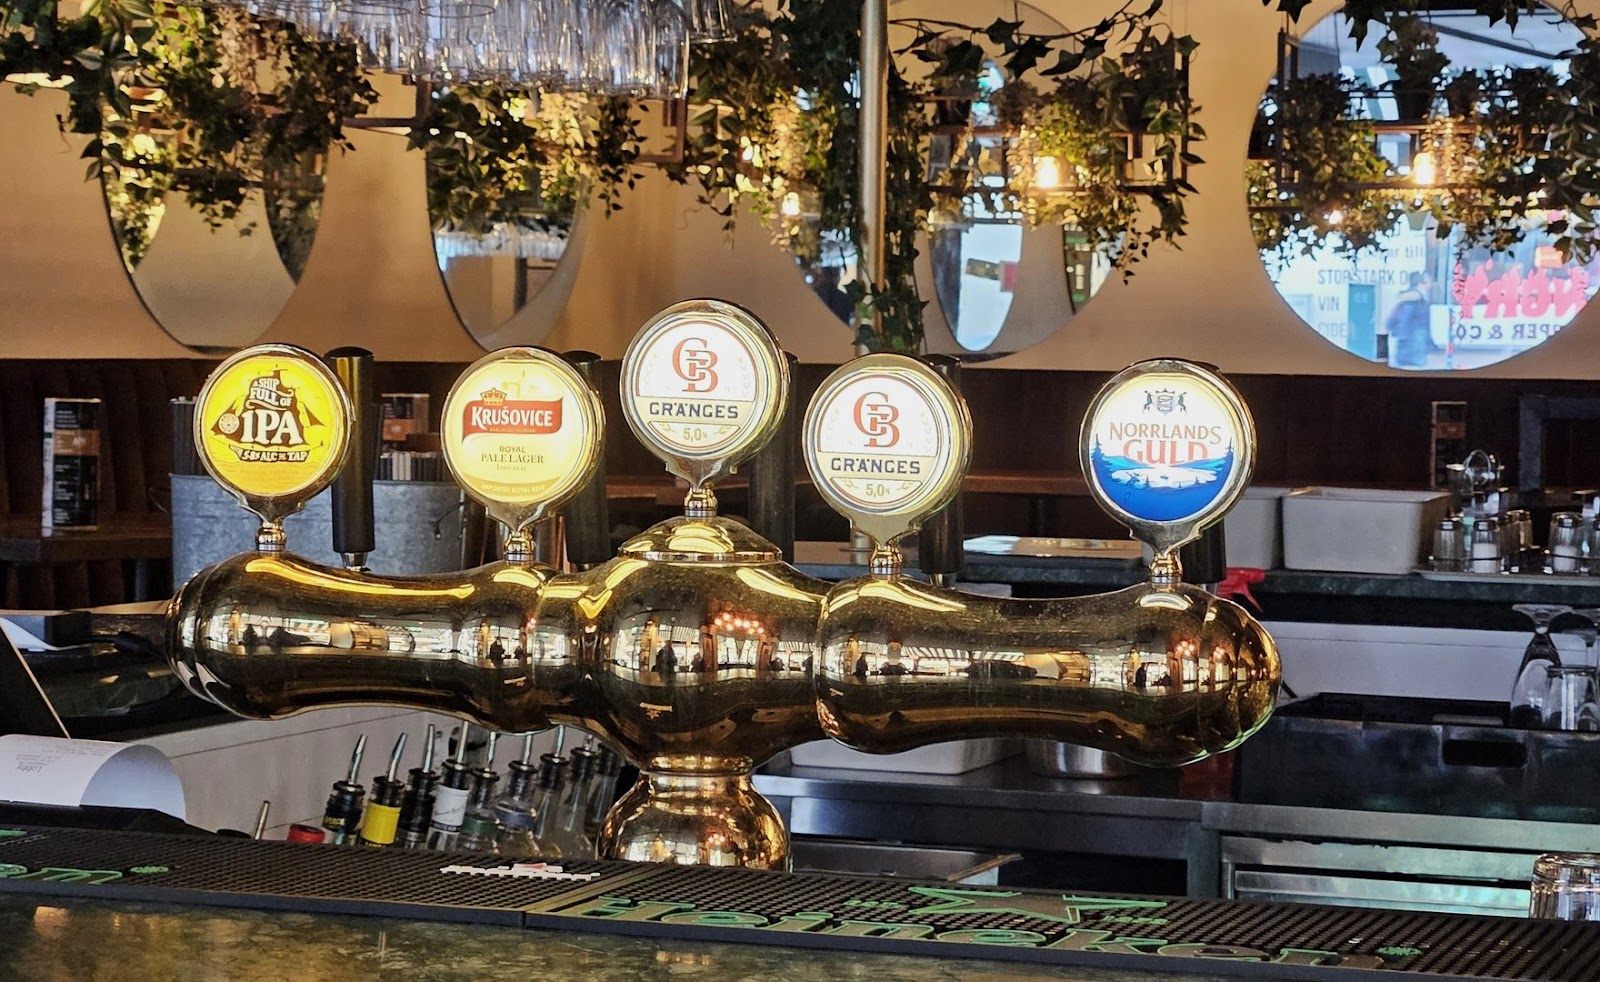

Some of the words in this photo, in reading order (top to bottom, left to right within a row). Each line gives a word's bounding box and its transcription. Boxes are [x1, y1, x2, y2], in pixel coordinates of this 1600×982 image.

[1317, 295, 1340, 312] VIN
[258, 377, 280, 391] SHIP
[249, 387, 279, 406] FULL
[280, 397, 293, 407] OF
[471, 406, 553, 431] KRUŠOVICE
[649, 401, 739, 419] GRÄNGES
[240, 408, 304, 445] IPA
[1109, 421, 1222, 445] NORRLANDS
[287, 451, 308, 461] TAP
[481, 453, 507, 463] PALE
[509, 453, 544, 464] LAGER
[499, 445, 526, 454] ROYAL
[1123, 439, 1209, 465] GULD
[831, 457, 921, 475] GRÄNGES
